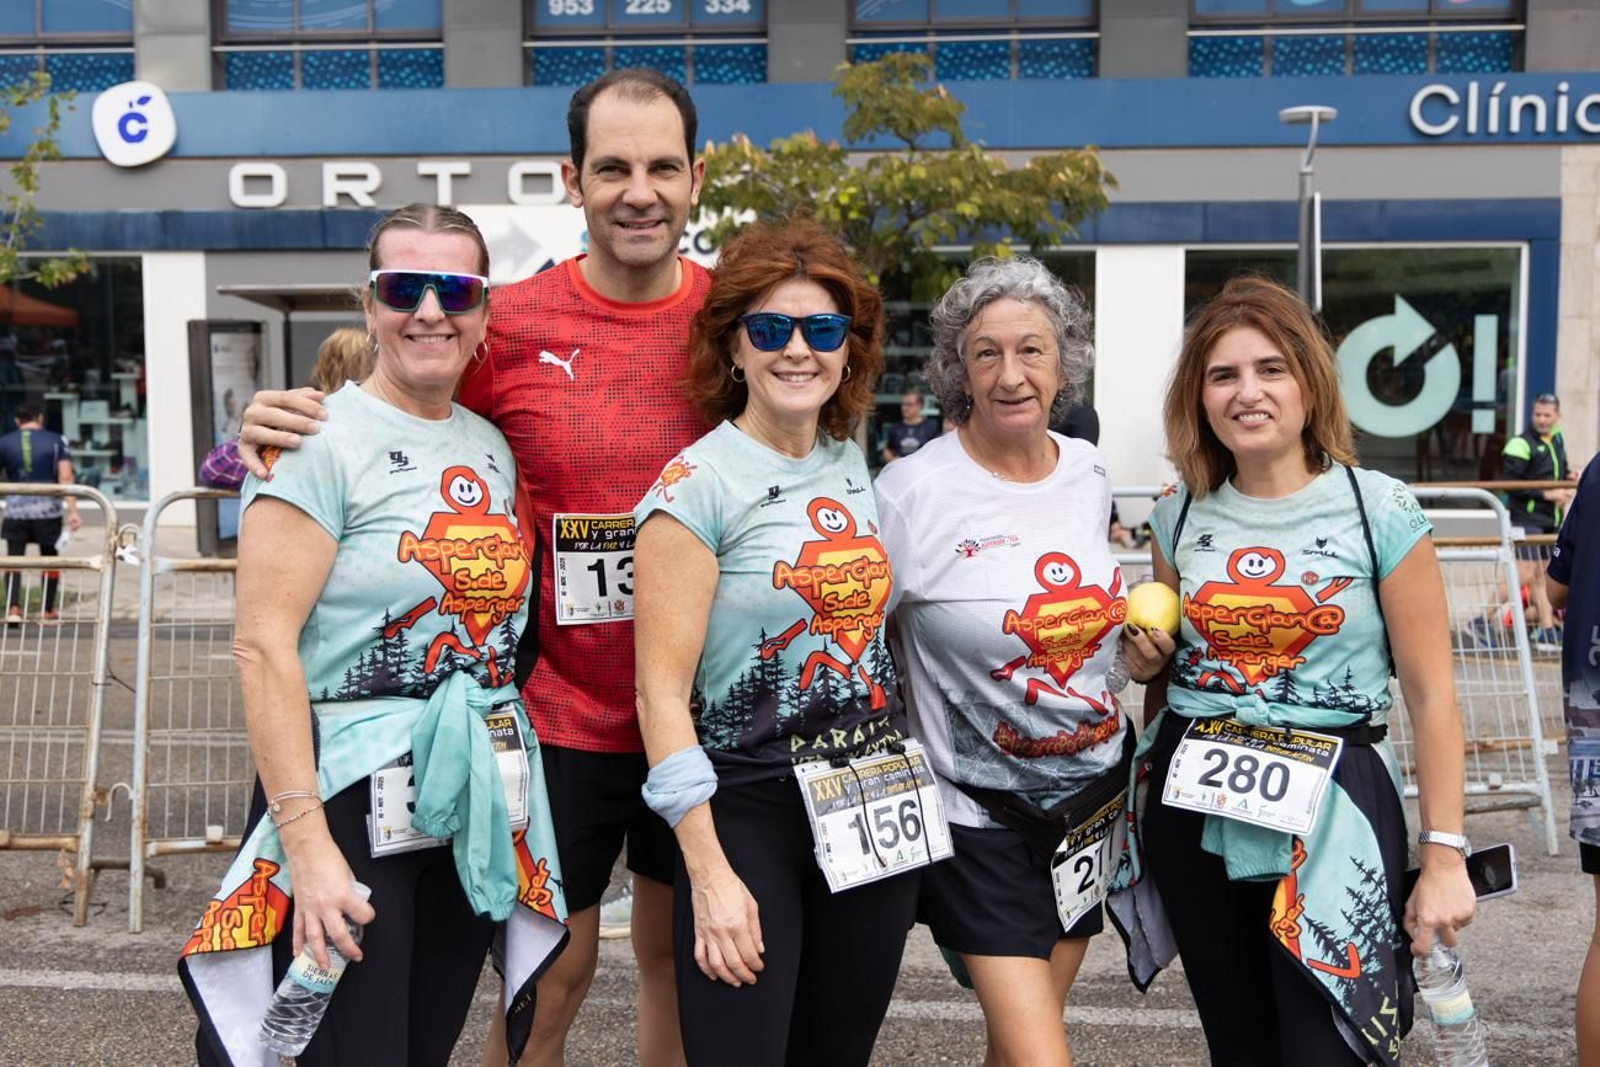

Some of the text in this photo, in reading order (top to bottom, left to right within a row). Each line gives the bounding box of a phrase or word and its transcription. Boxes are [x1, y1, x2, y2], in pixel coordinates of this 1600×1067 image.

[549, 0, 751, 16] 953 225 334
[560, 519, 590, 539] XXV
[812, 773, 844, 802] XXV
[1197, 747, 1291, 803] 280
[847, 798, 922, 856] 156
